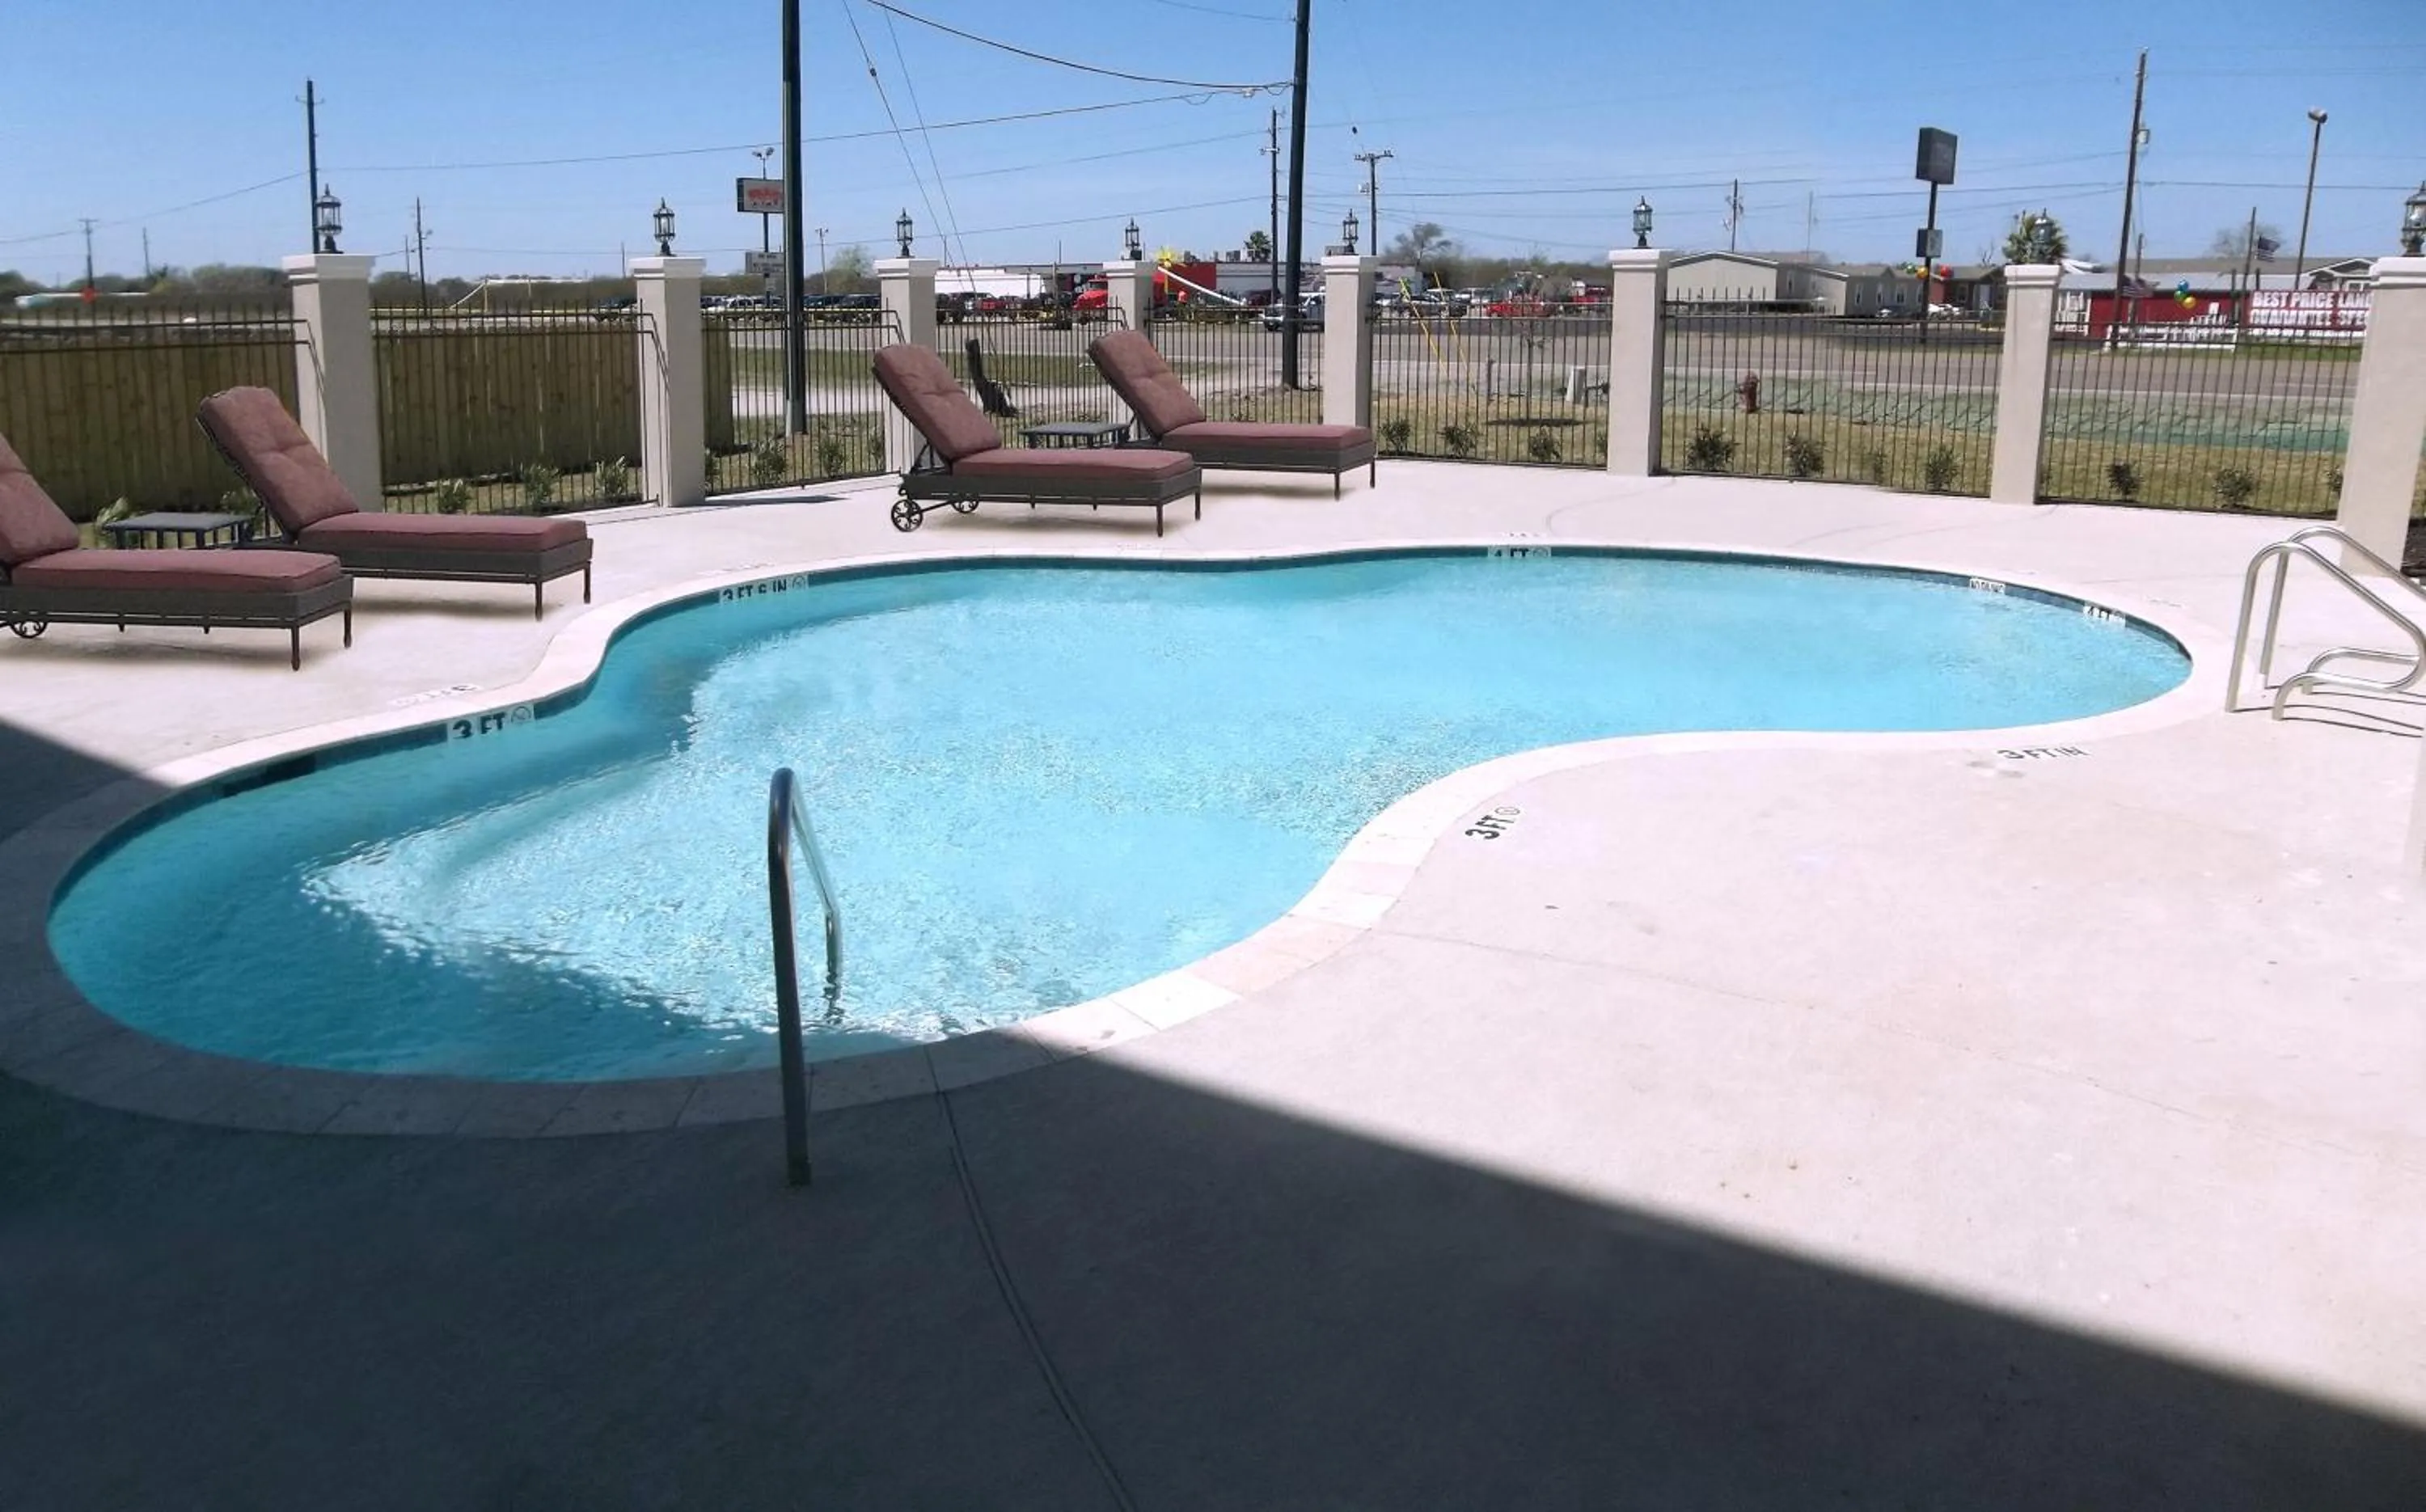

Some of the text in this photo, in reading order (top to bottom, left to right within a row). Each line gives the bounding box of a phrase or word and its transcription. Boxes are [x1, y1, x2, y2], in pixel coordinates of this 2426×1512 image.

[2252, 292, 2335, 309] BEST PRICE
[772, 579, 788, 593] IN
[452, 712, 506, 739] 3 FT
[1997, 749, 2025, 759] 3
[1464, 828, 1500, 840] 3
